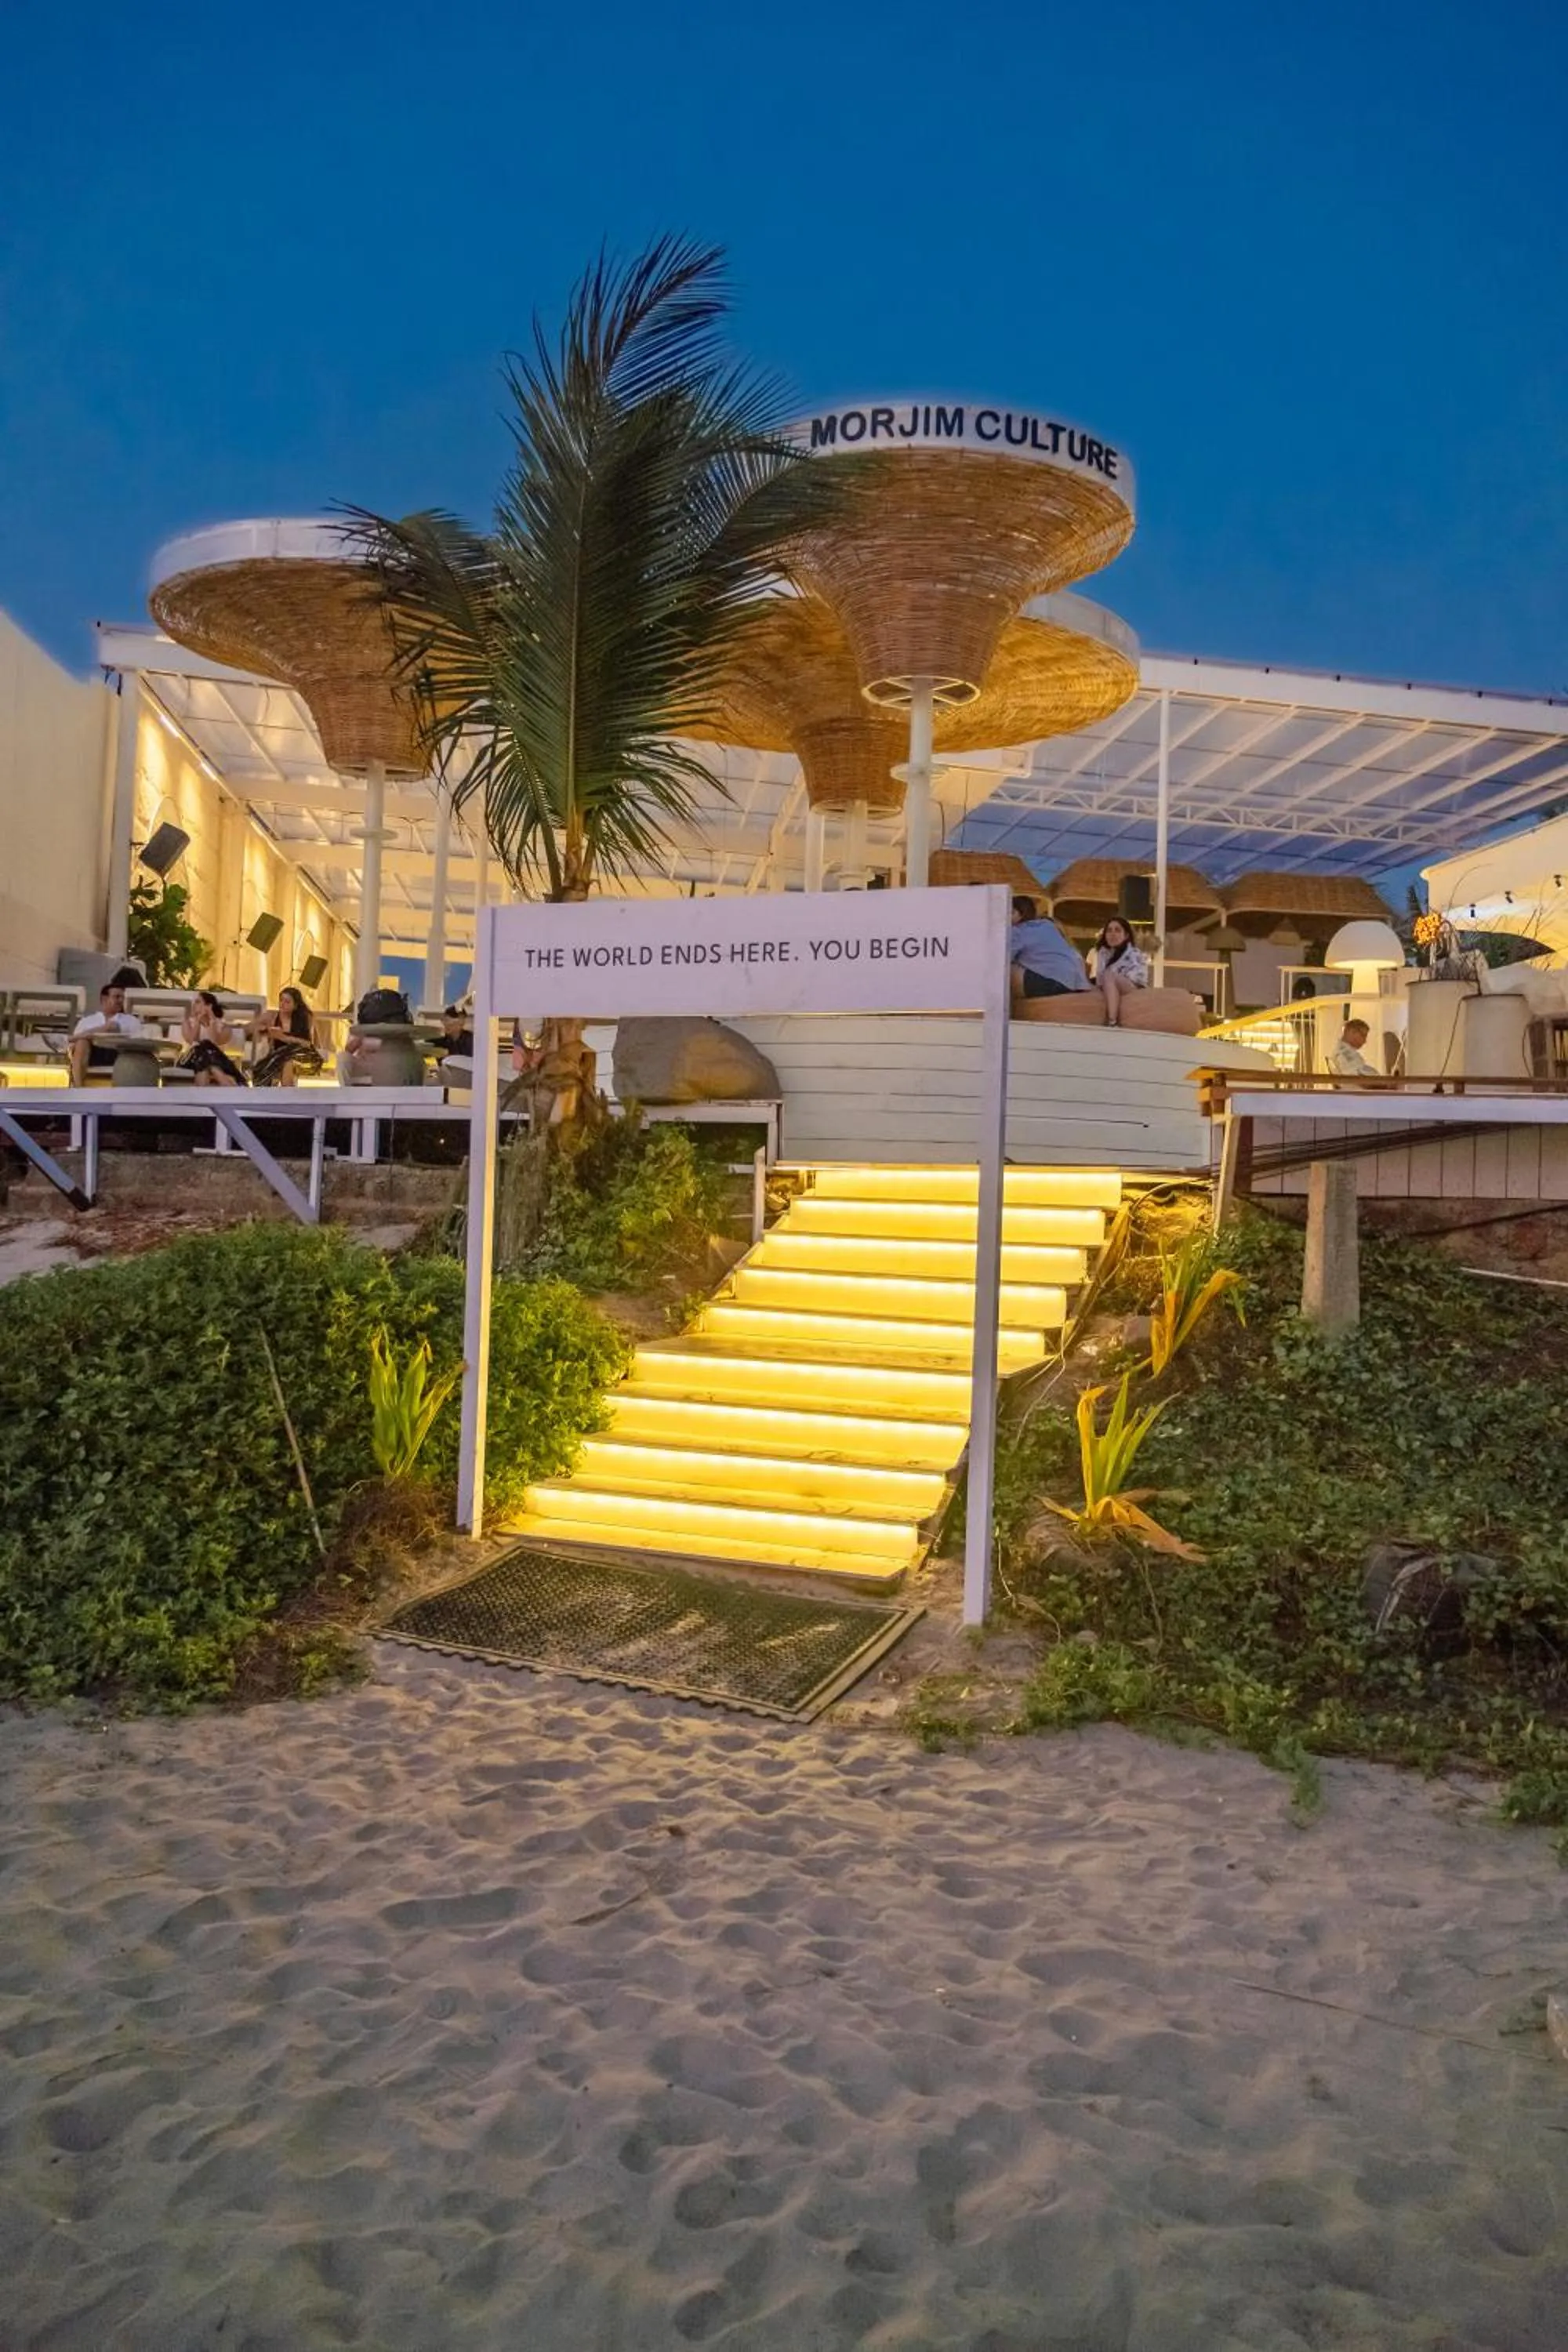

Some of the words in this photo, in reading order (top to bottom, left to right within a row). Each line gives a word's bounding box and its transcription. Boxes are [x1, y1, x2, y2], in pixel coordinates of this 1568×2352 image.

[809, 405, 964, 448] MORJIM
[975, 408, 1118, 480] CULTURE
[524, 948, 564, 969] THE
[572, 946, 653, 967] WORLD
[661, 943, 722, 966] ENDS
[730, 941, 800, 964] HERE.
[809, 939, 861, 961] YOU
[869, 936, 949, 960] BEGIN
